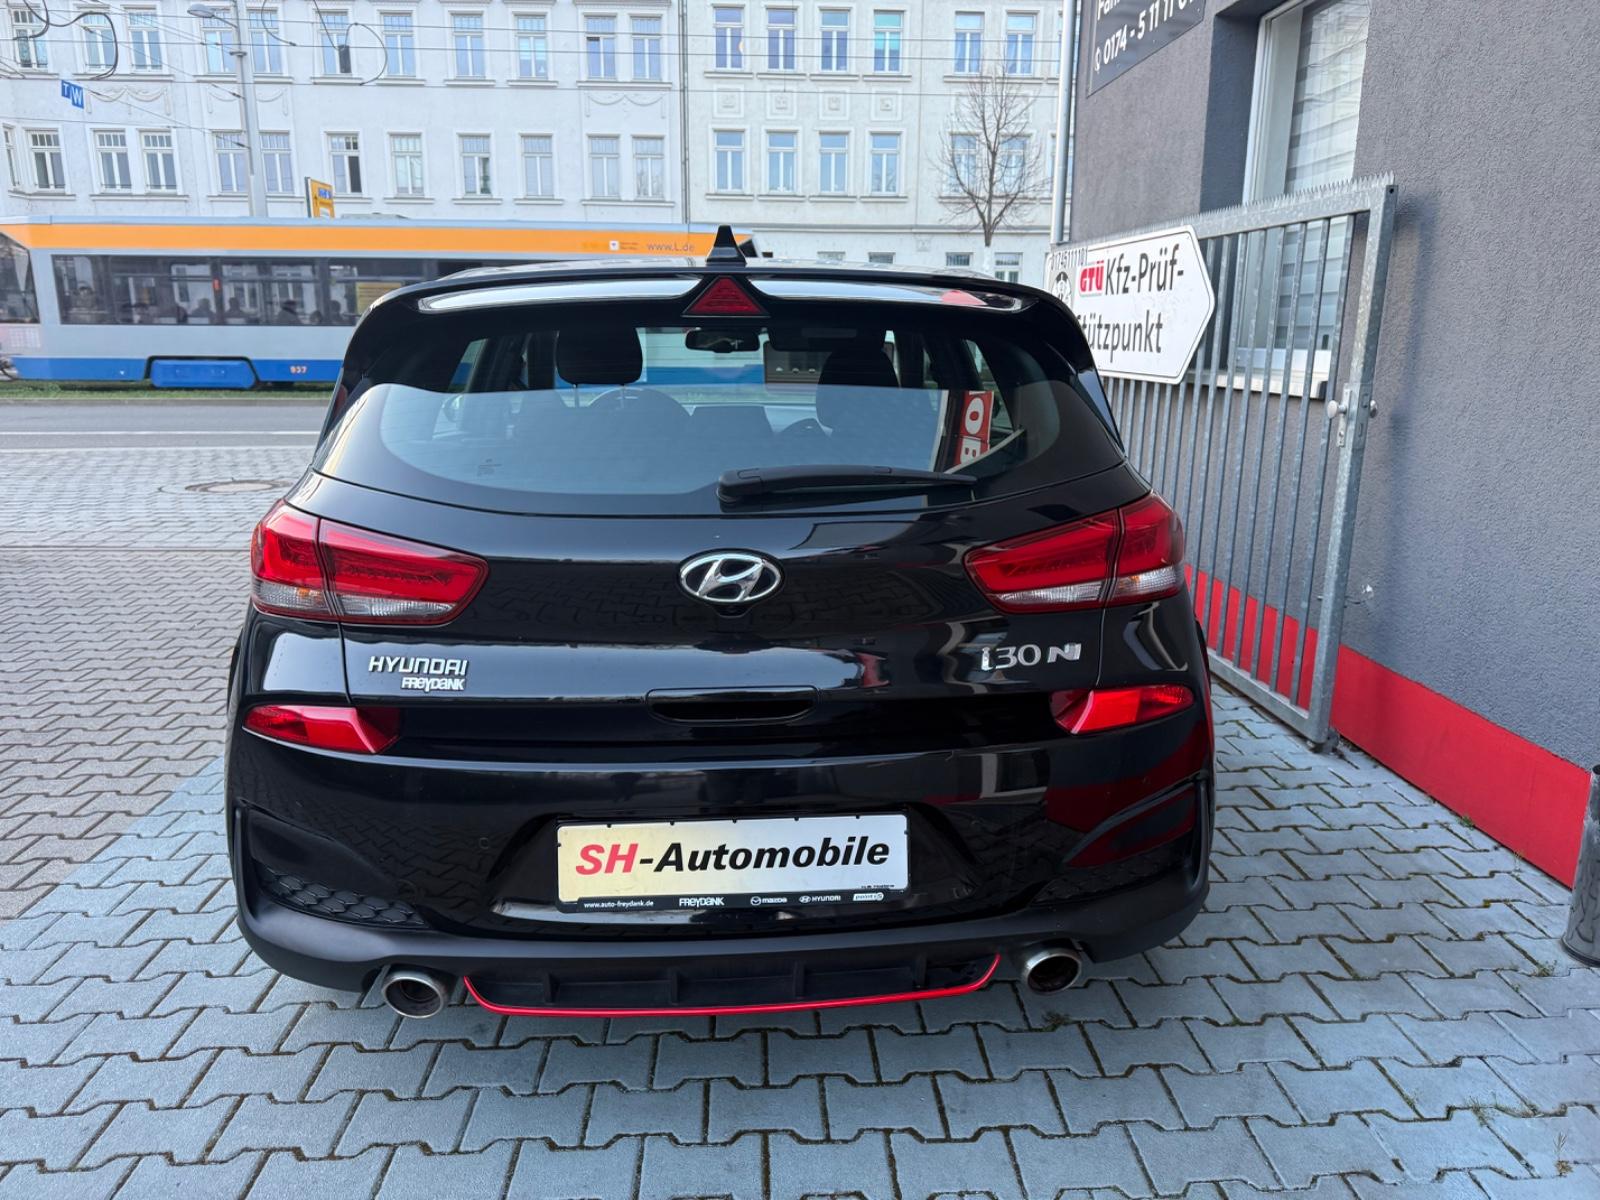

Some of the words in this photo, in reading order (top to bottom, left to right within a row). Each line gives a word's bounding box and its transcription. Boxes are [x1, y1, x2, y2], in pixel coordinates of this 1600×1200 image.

[1103, 24, 1128, 65] 0174
[645, 242, 695, 252] www.L.de
[1080, 260, 1104, 292] GTÜ
[1105, 243, 1184, 295] Kfz-Prüf-
[1077, 310, 1163, 363] tützpunkt
[368, 655, 468, 676] HYUNDAI
[981, 644, 1042, 671] i30
[1047, 643, 1082, 663] N
[575, 835, 890, 875] SH-Automobile
[583, 899, 654, 909] www.auto-freydank.de
[811, 895, 842, 903] HYUNDAI
